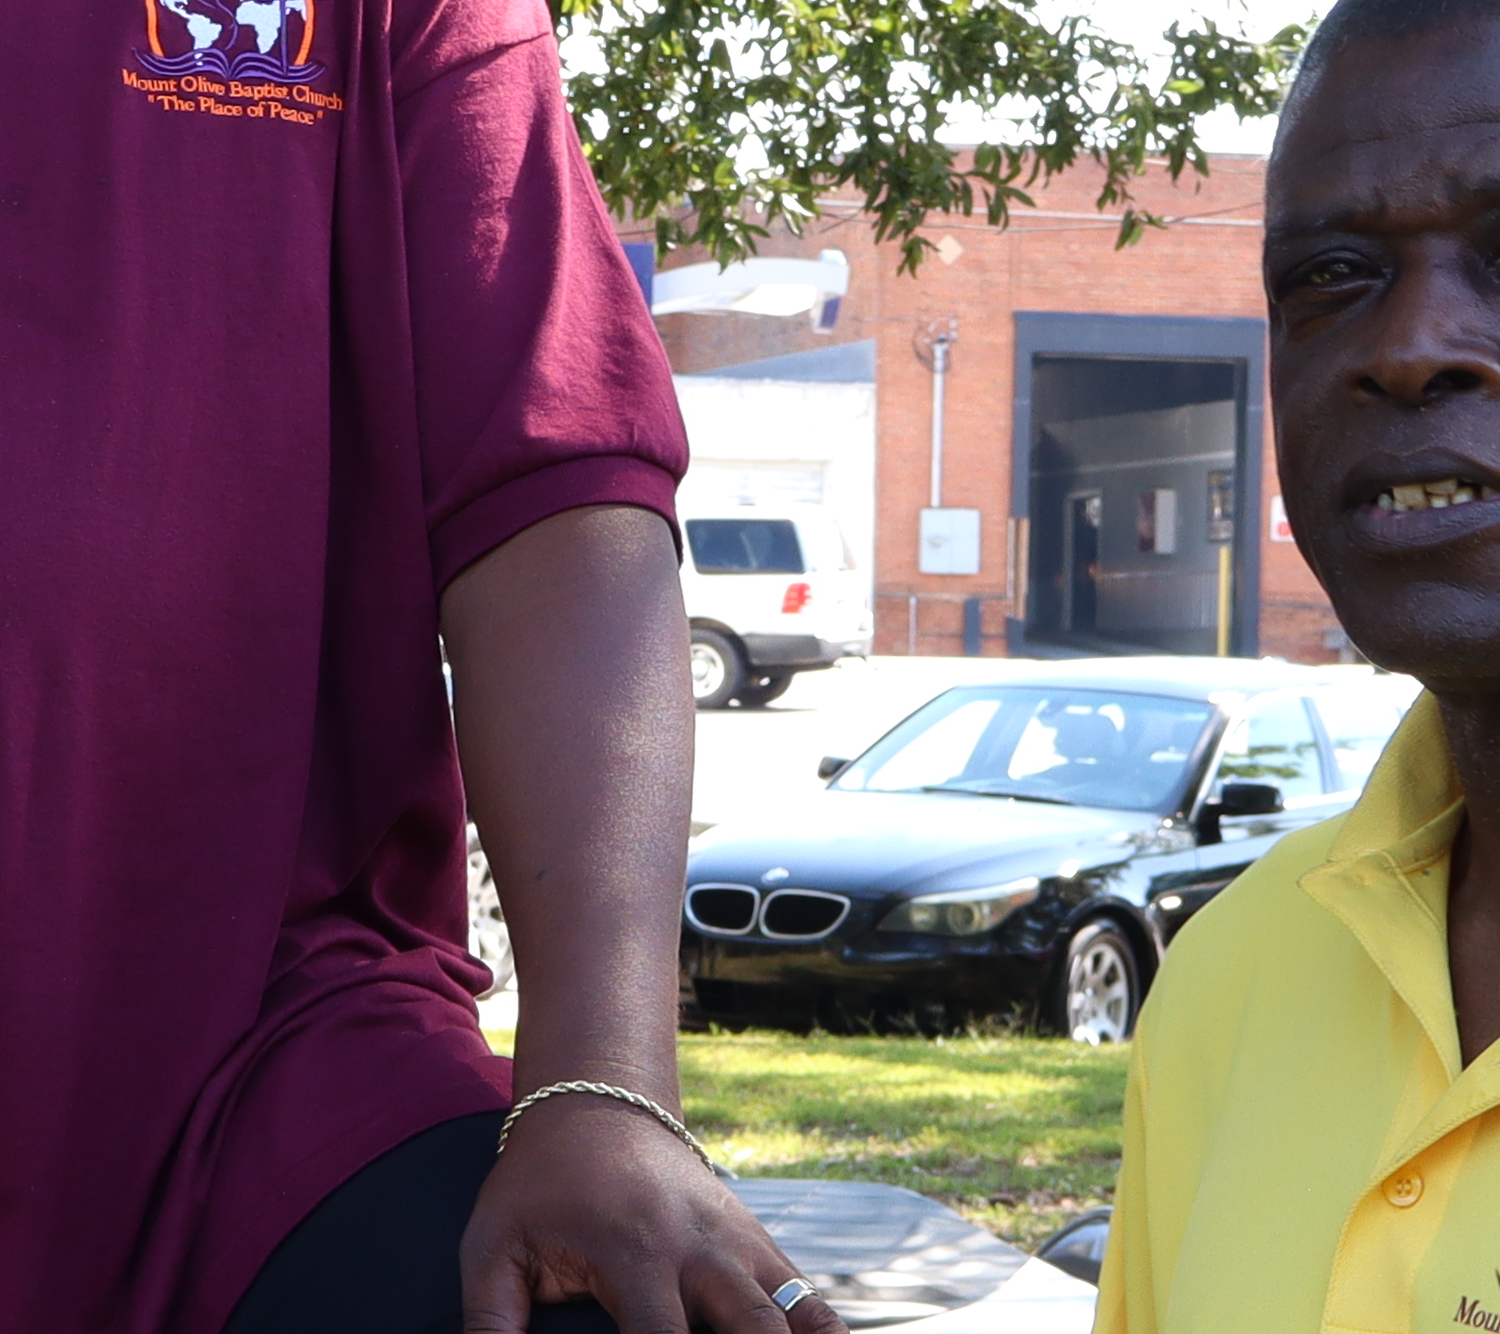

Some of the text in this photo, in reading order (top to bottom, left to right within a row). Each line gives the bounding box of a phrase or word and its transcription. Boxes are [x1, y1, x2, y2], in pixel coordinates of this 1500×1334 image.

[121, 68, 344, 111] Mount Olive Baptist Church
[198, 95, 244, 116] Place
[246, 100, 267, 118] of
